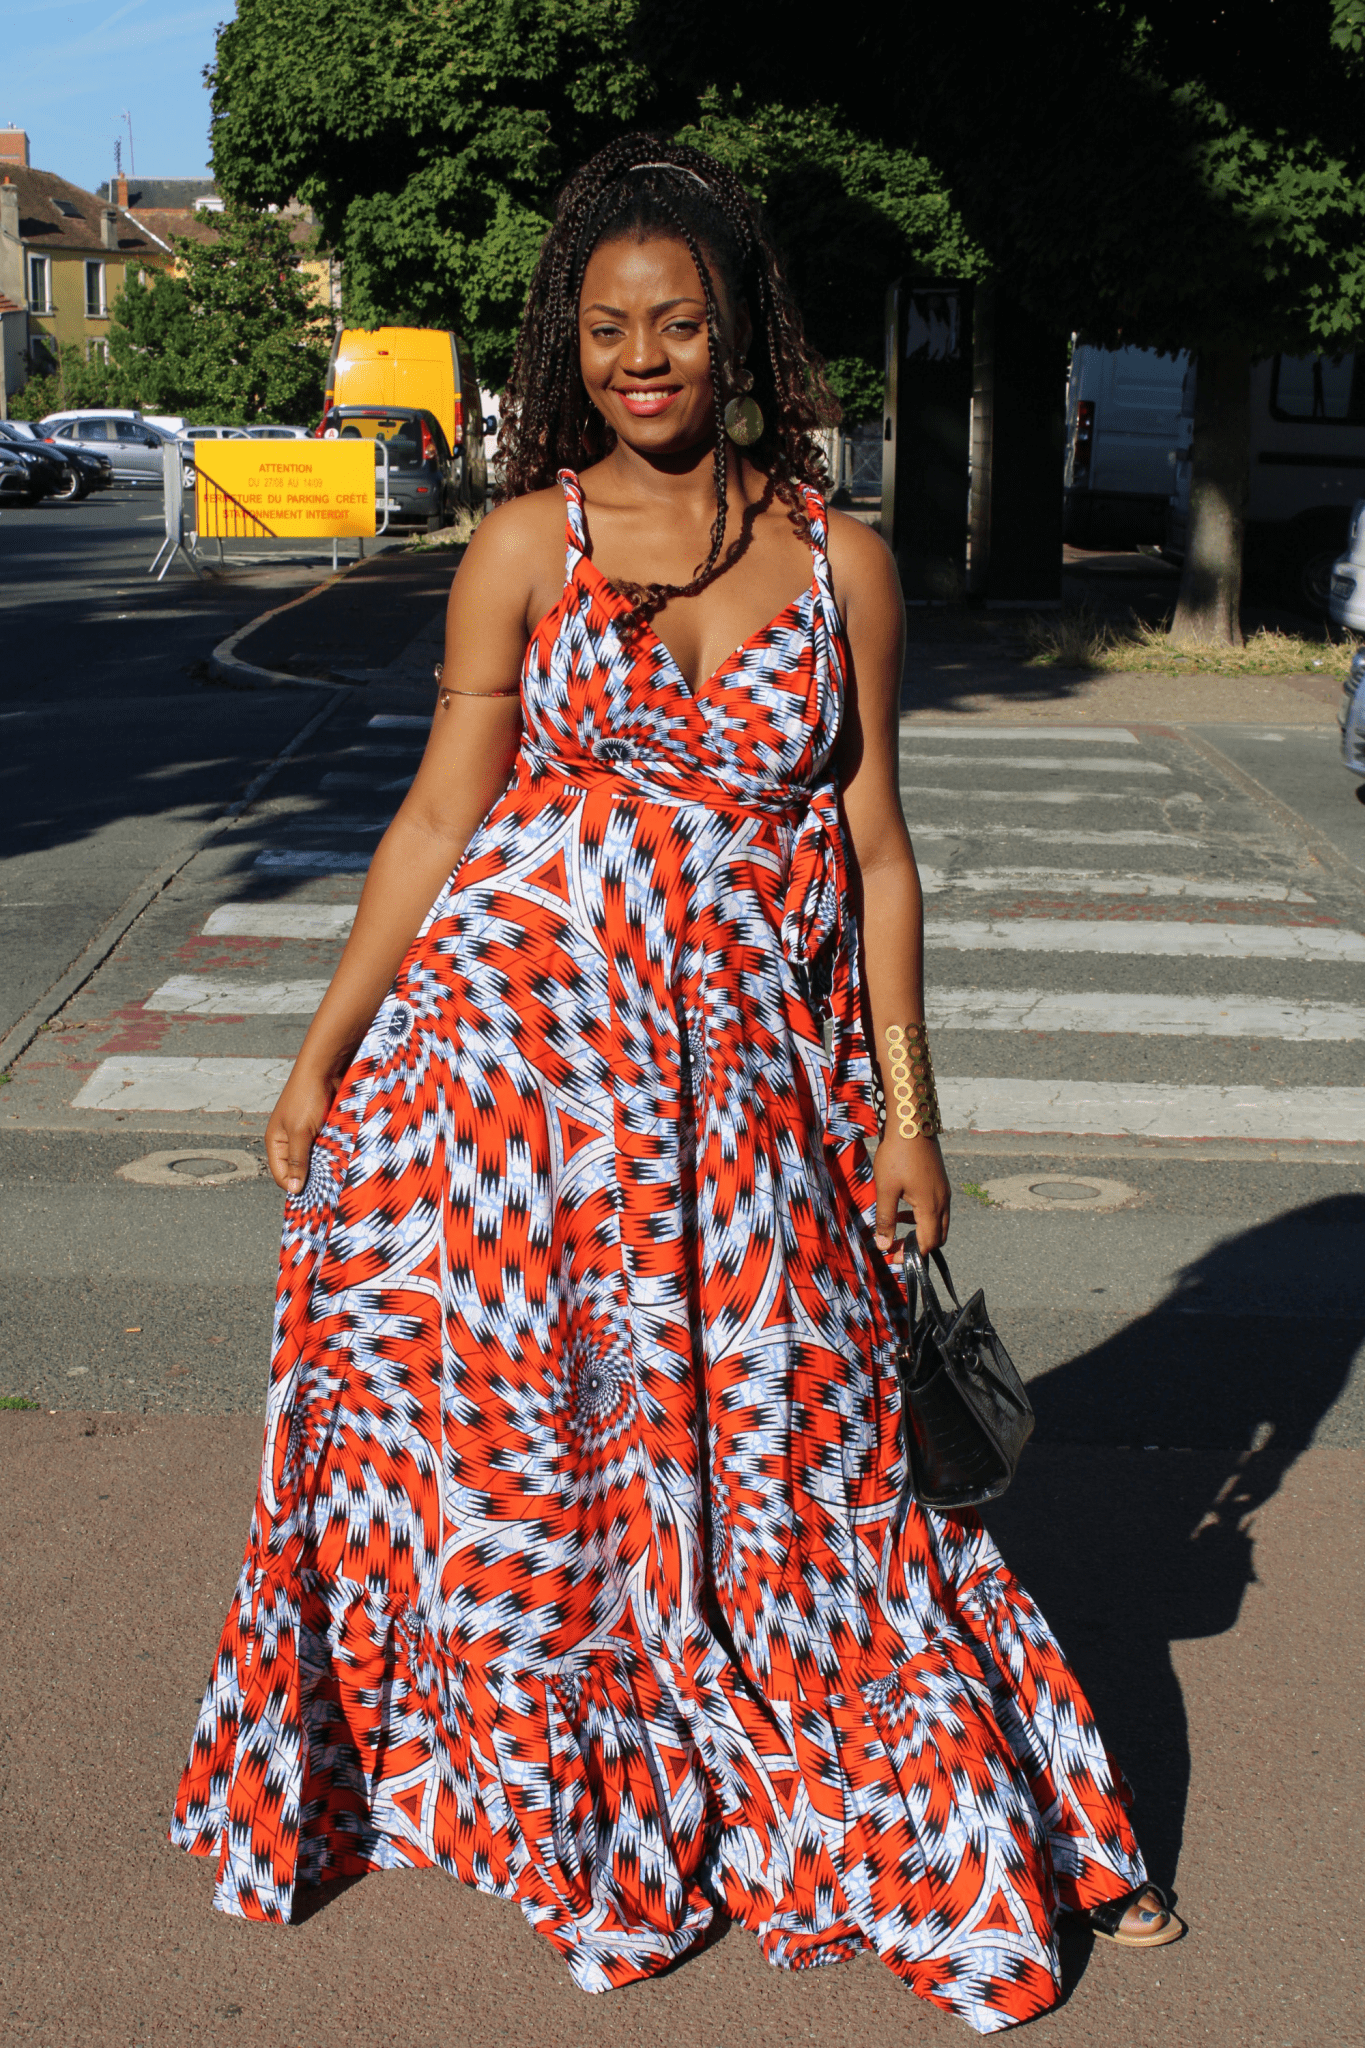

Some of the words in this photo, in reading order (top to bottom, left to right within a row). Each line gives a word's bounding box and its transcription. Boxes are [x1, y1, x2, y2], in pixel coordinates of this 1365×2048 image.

[259, 464, 312, 474] ATTENTION
[248, 477, 260, 487] DU
[287, 477, 299, 487] AU
[267, 494, 281, 504] DU
[287, 494, 329, 504] PARKING
[306, 509, 350, 519] INTERDIT
